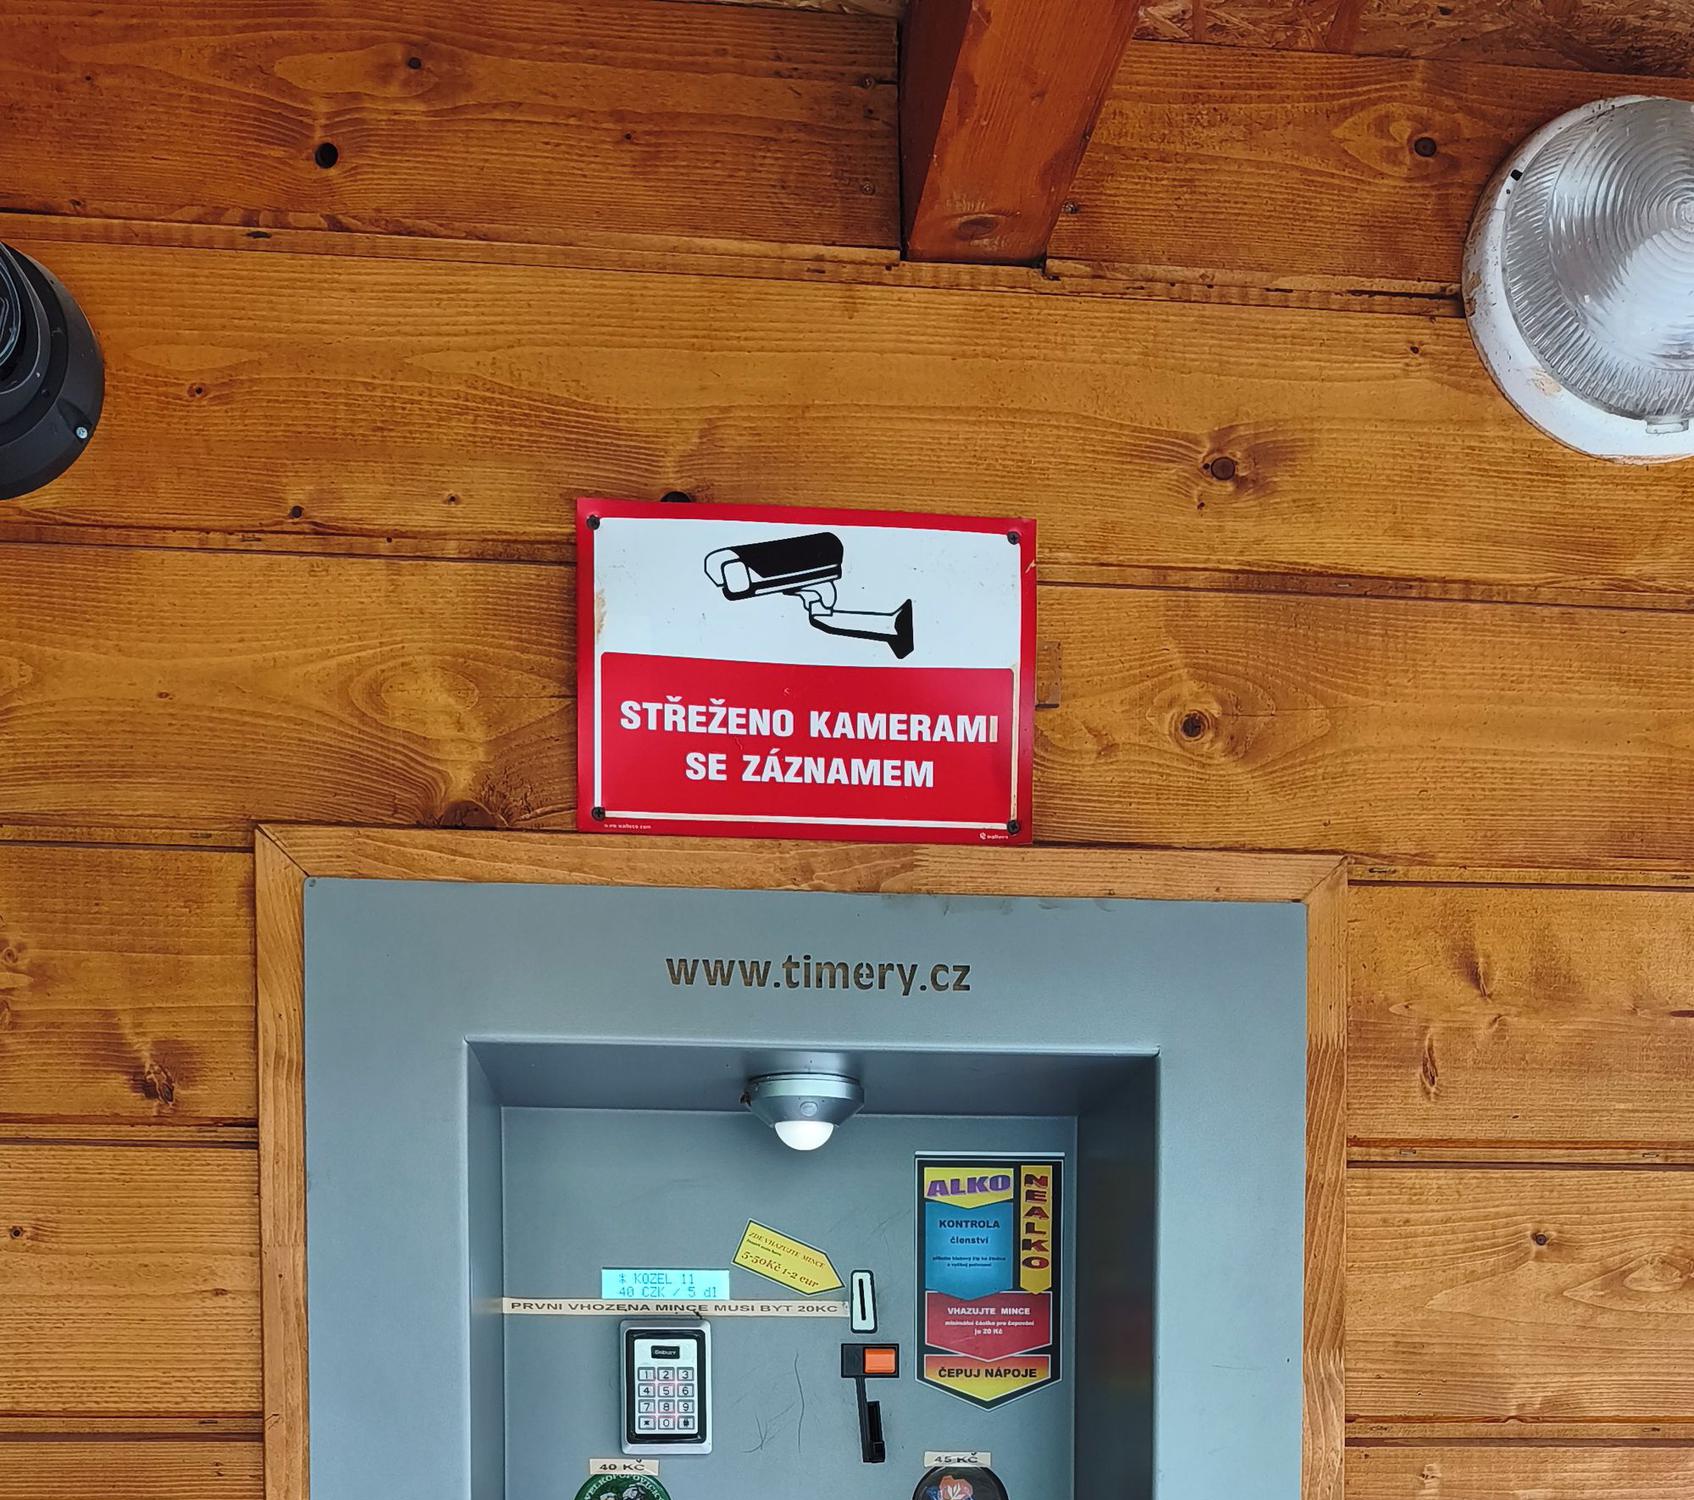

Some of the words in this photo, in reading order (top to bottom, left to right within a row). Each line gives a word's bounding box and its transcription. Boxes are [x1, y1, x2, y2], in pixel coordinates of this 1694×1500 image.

[620, 695, 794, 737] STŘEŽENO
[810, 710, 998, 742] KAMERAMI
[685, 752, 727, 781] SE
[742, 748, 934, 788] ZÁZNAMEM
[666, 954, 971, 996] www.timery.cz
[927, 1175, 1011, 1197] ALKO
[939, 1220, 1000, 1229] KONTROLA
[1022, 1174, 1049, 1270] NEALKO
[950, 1236, 989, 1244] členství
[741, 1251, 781, 1272] 5-50Kč
[782, 1268, 798, 1279] 1-2
[800, 1276, 819, 1287] eur
[634, 1273, 672, 1284] KOZEL
[682, 1273, 694, 1284] 11
[619, 1286, 634, 1297] 40
[642, 1286, 665, 1297] CZK
[673, 1287, 680, 1296] /
[688, 1287, 696, 1297] 5
[511, 1302, 562, 1311] PRVNI
[568, 1303, 650, 1312] VHOZENA
[656, 1304, 708, 1312] MINCE
[714, 1304, 755, 1312] MUSI
[797, 1305, 838, 1313] 20KC
[948, 1307, 996, 1315] VHAZUJTE
[1001, 1307, 1030, 1315] MINCE
[644, 1370, 649, 1379] 1
[663, 1370, 669, 1379] 2
[682, 1370, 689, 1379] 3
[939, 1366, 980, 1378] ČEPUJ
[985, 1366, 1037, 1378] NÁPOJE
[643, 1386, 650, 1394] 4
[662, 1386, 670, 1396] 5
[682, 1386, 689, 1396] 6
[643, 1402, 650, 1411] 7
[662, 1402, 670, 1411] 8
[682, 1402, 689, 1411] 9
[662, 1419, 670, 1427] 0
